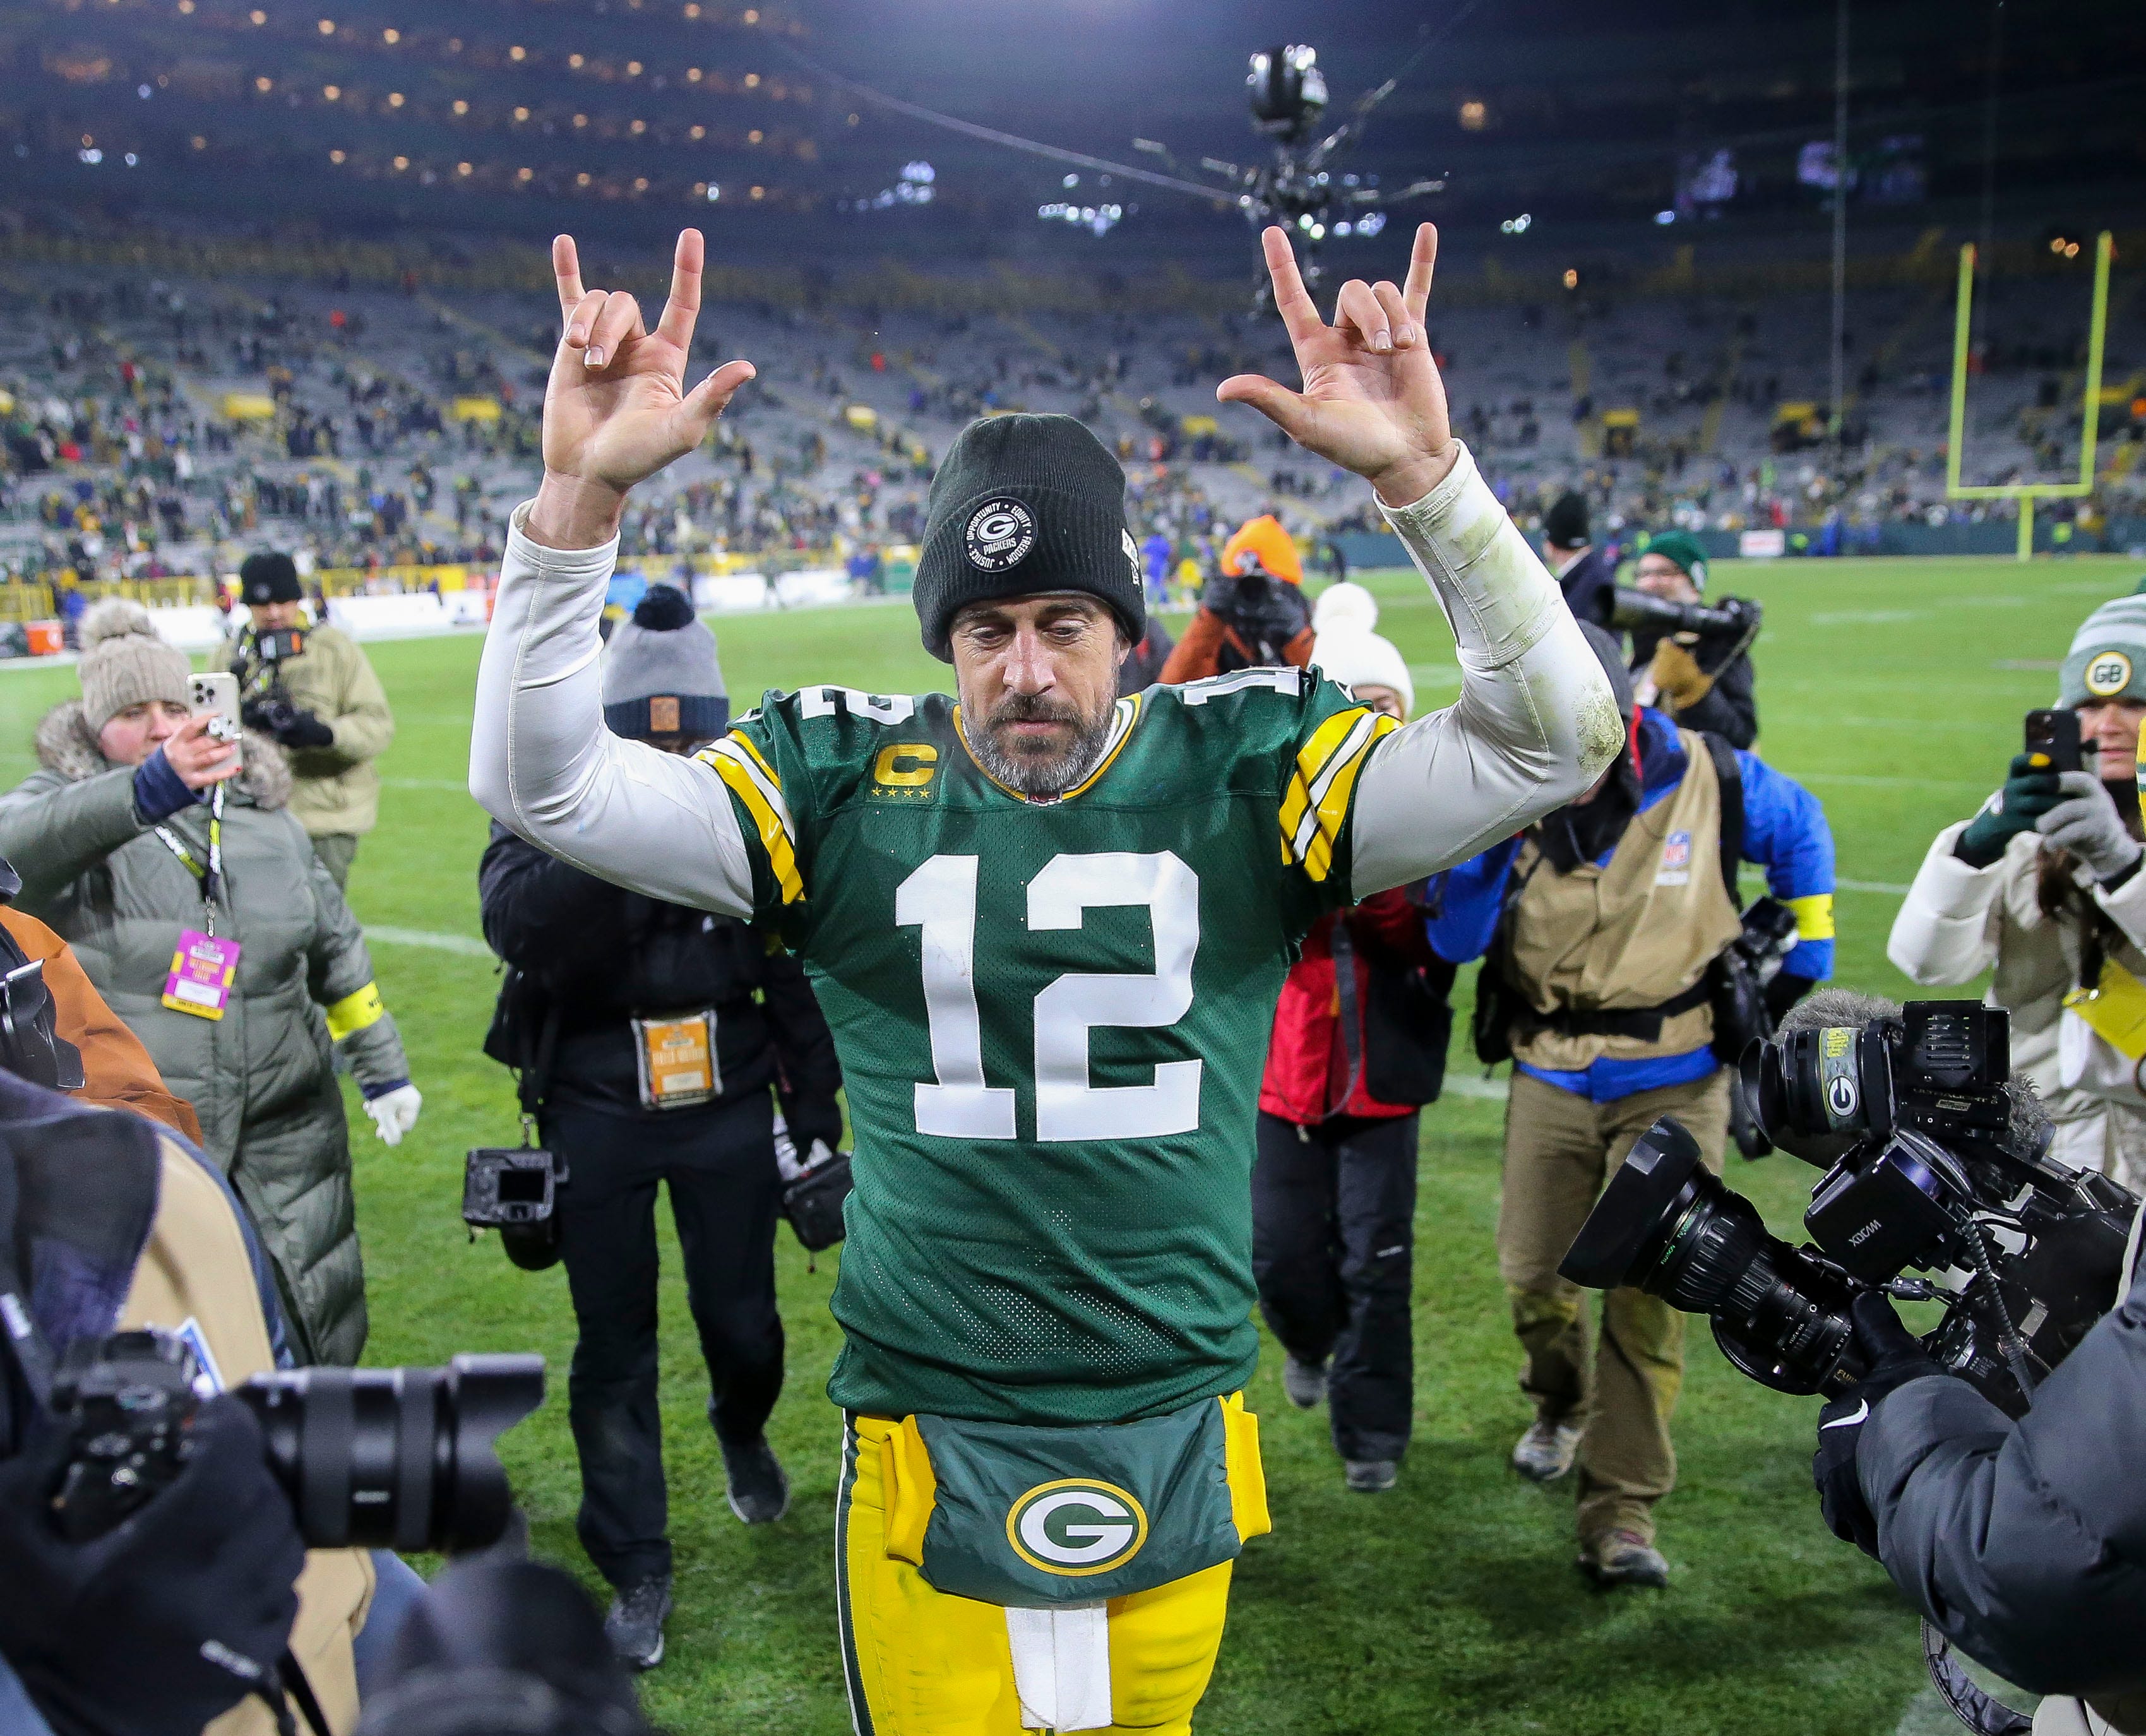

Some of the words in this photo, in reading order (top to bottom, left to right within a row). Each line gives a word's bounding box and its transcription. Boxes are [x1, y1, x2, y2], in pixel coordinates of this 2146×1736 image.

[967, 502, 1001, 541] OPPORTUNITY
[1010, 505, 1032, 528] EQUITY
[969, 548, 996, 569] JUSTICE
[983, 537, 1017, 556] PACKERS
[1006, 535, 1032, 565] FREEDOM
[2094, 664, 2123, 683] GB
[874, 744, 939, 787] C
[895, 848, 1202, 1142] 12
[1849, 1220, 1881, 1247] XDCAM
[1020, 1491, 1134, 1564] G
